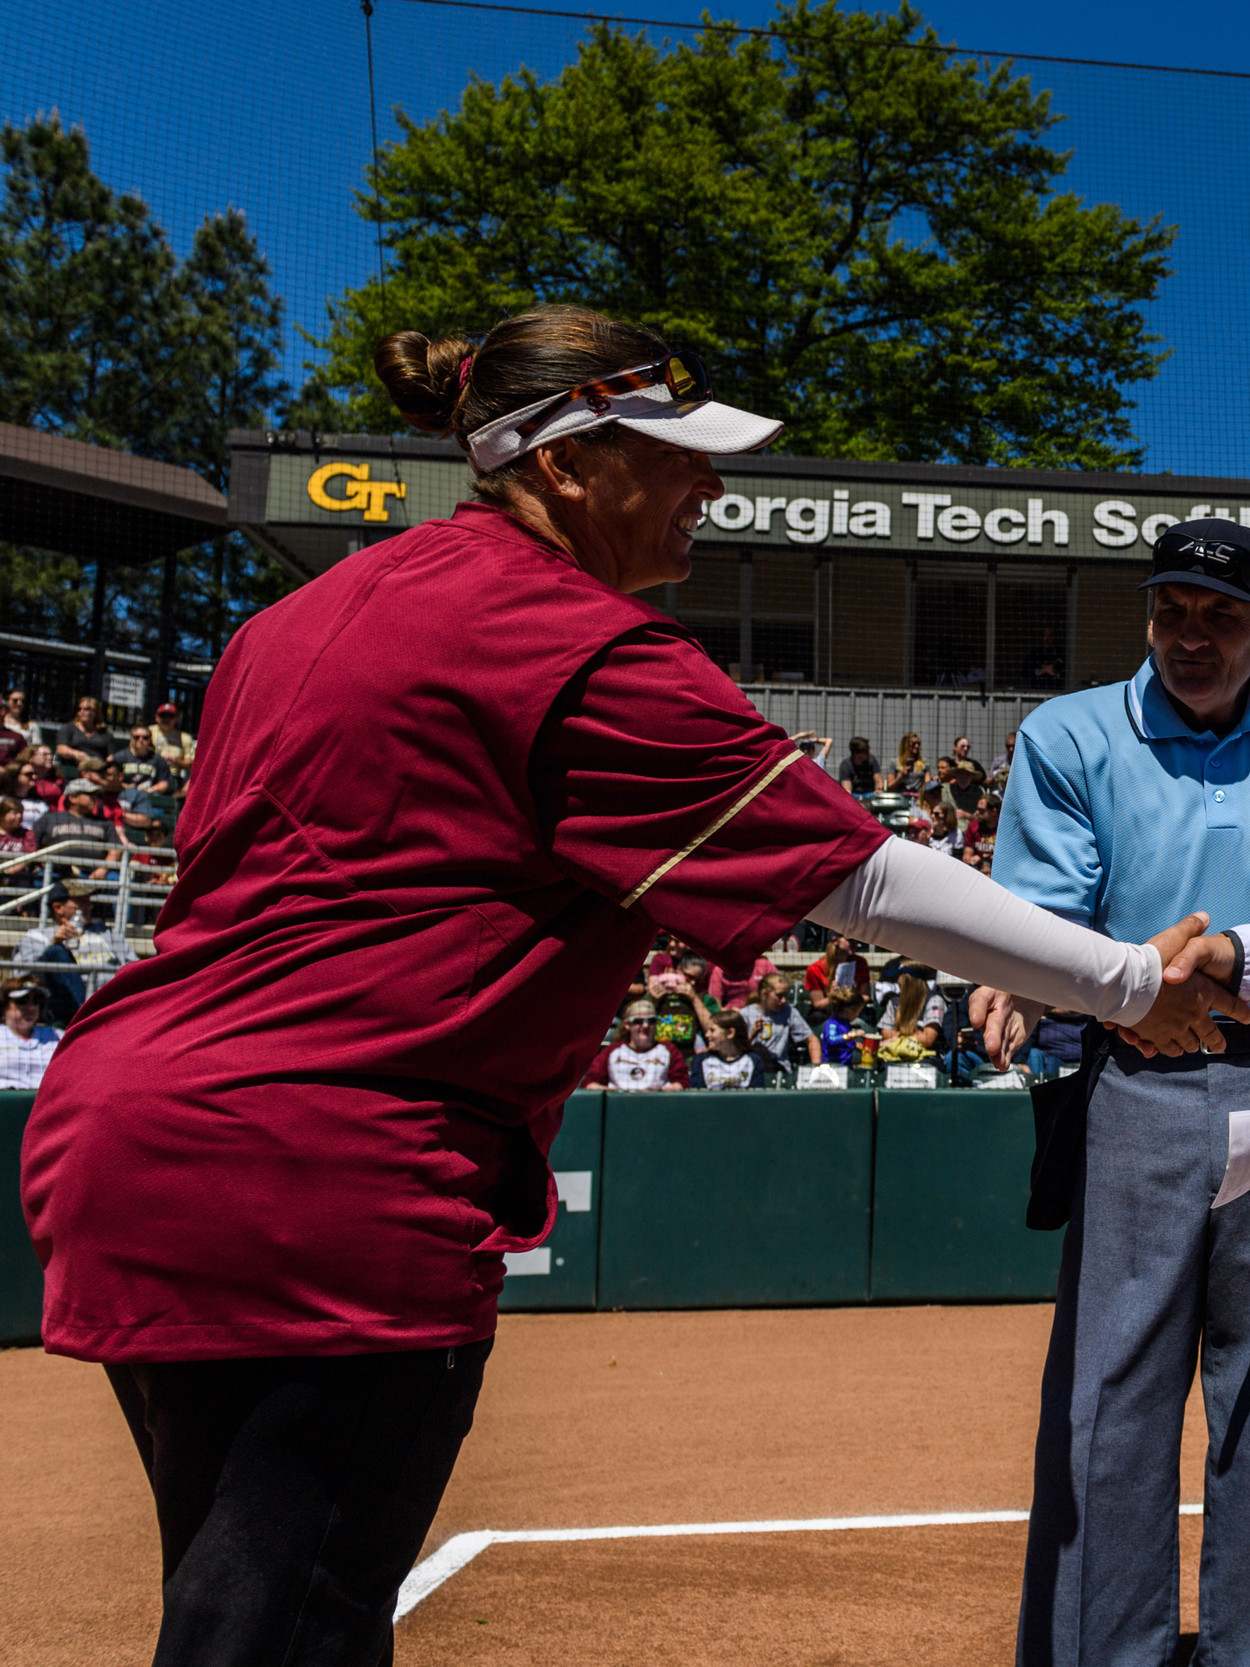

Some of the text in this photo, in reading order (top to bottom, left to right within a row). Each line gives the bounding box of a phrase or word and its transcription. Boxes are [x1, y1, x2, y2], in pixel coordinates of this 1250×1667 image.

[307, 462, 406, 522] GT
[695, 489, 891, 545] orgia
[901, 492, 1069, 545] Tech
